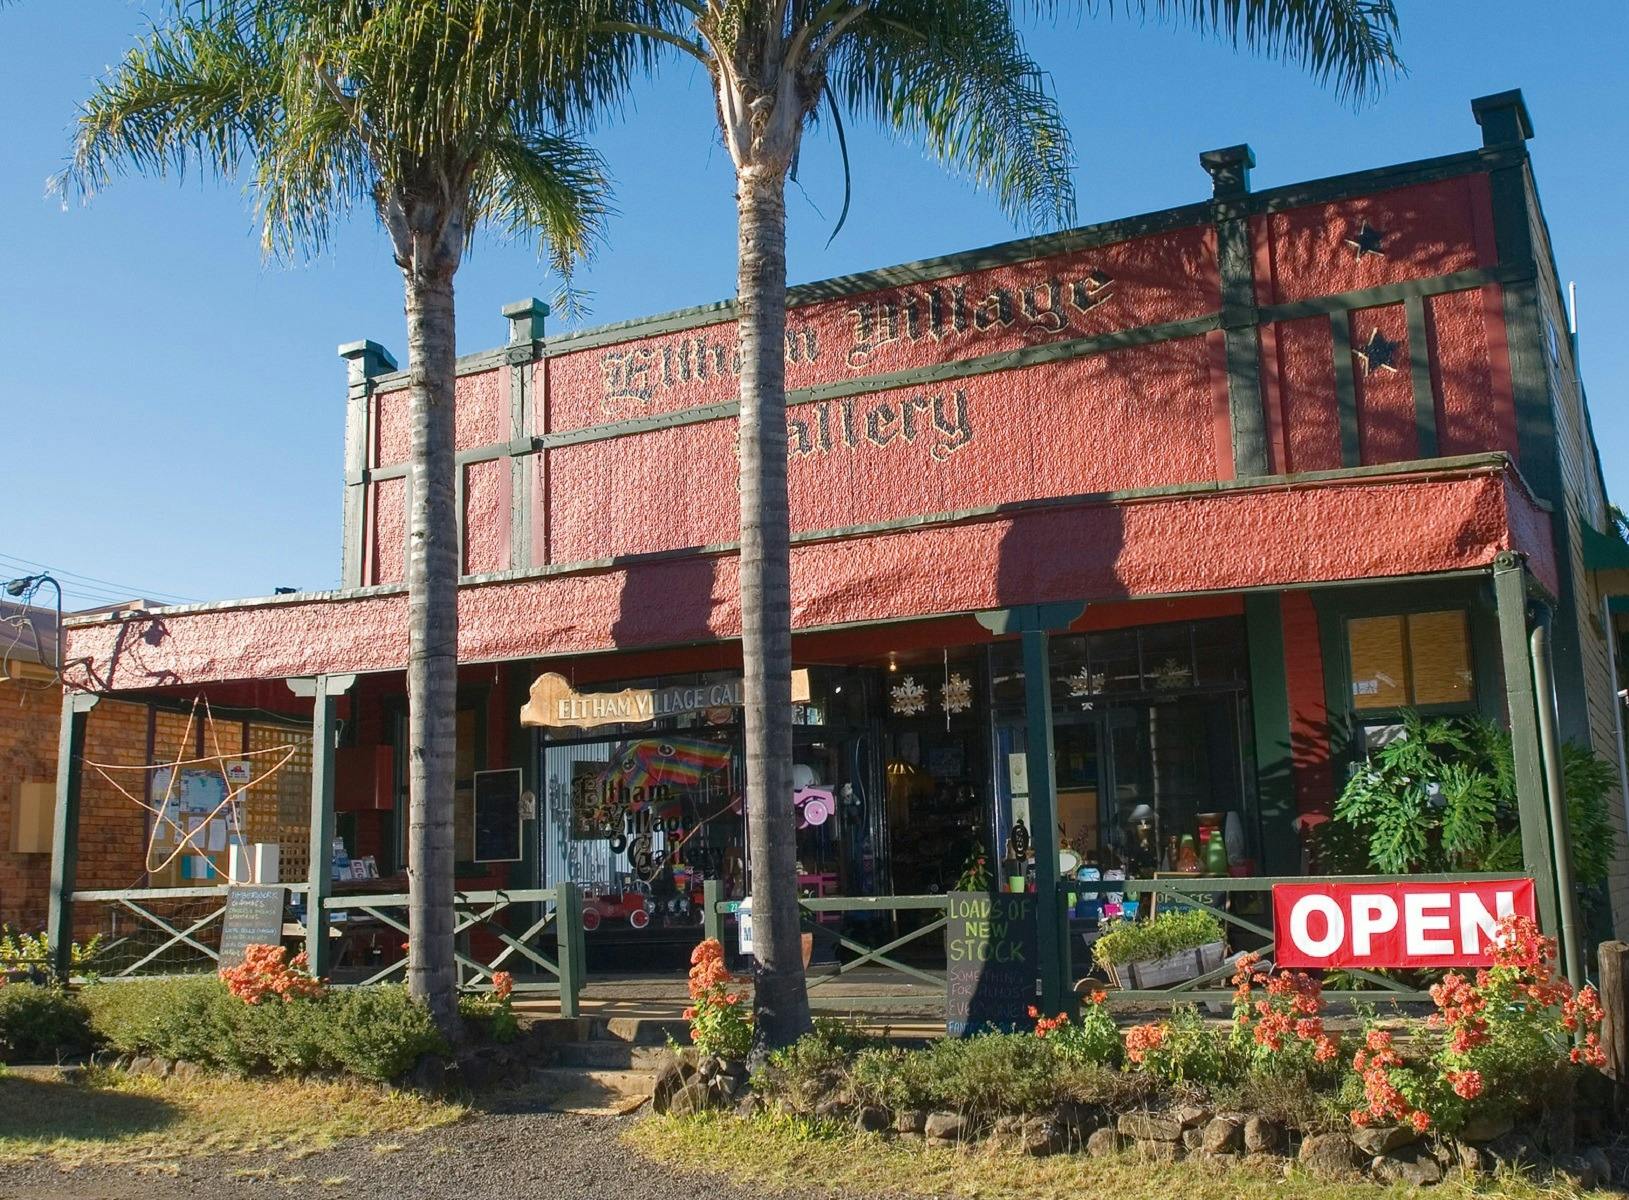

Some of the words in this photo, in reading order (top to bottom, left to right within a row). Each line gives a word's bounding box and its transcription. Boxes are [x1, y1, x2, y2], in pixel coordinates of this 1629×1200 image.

[600, 334, 818, 414] Elthm
[846, 268, 1115, 369] Village
[735, 387, 974, 491] allery
[558, 698, 631, 720] ELTHAM
[635, 688, 705, 716] VILLAGE
[950, 899, 1004, 920] LOADS
[1008, 899, 1032, 920] OF
[965, 921, 1008, 938] NEW
[1289, 891, 1516, 958] OPEN
[950, 939, 1025, 962] STOCK
[951, 983, 973, 996] FOR
